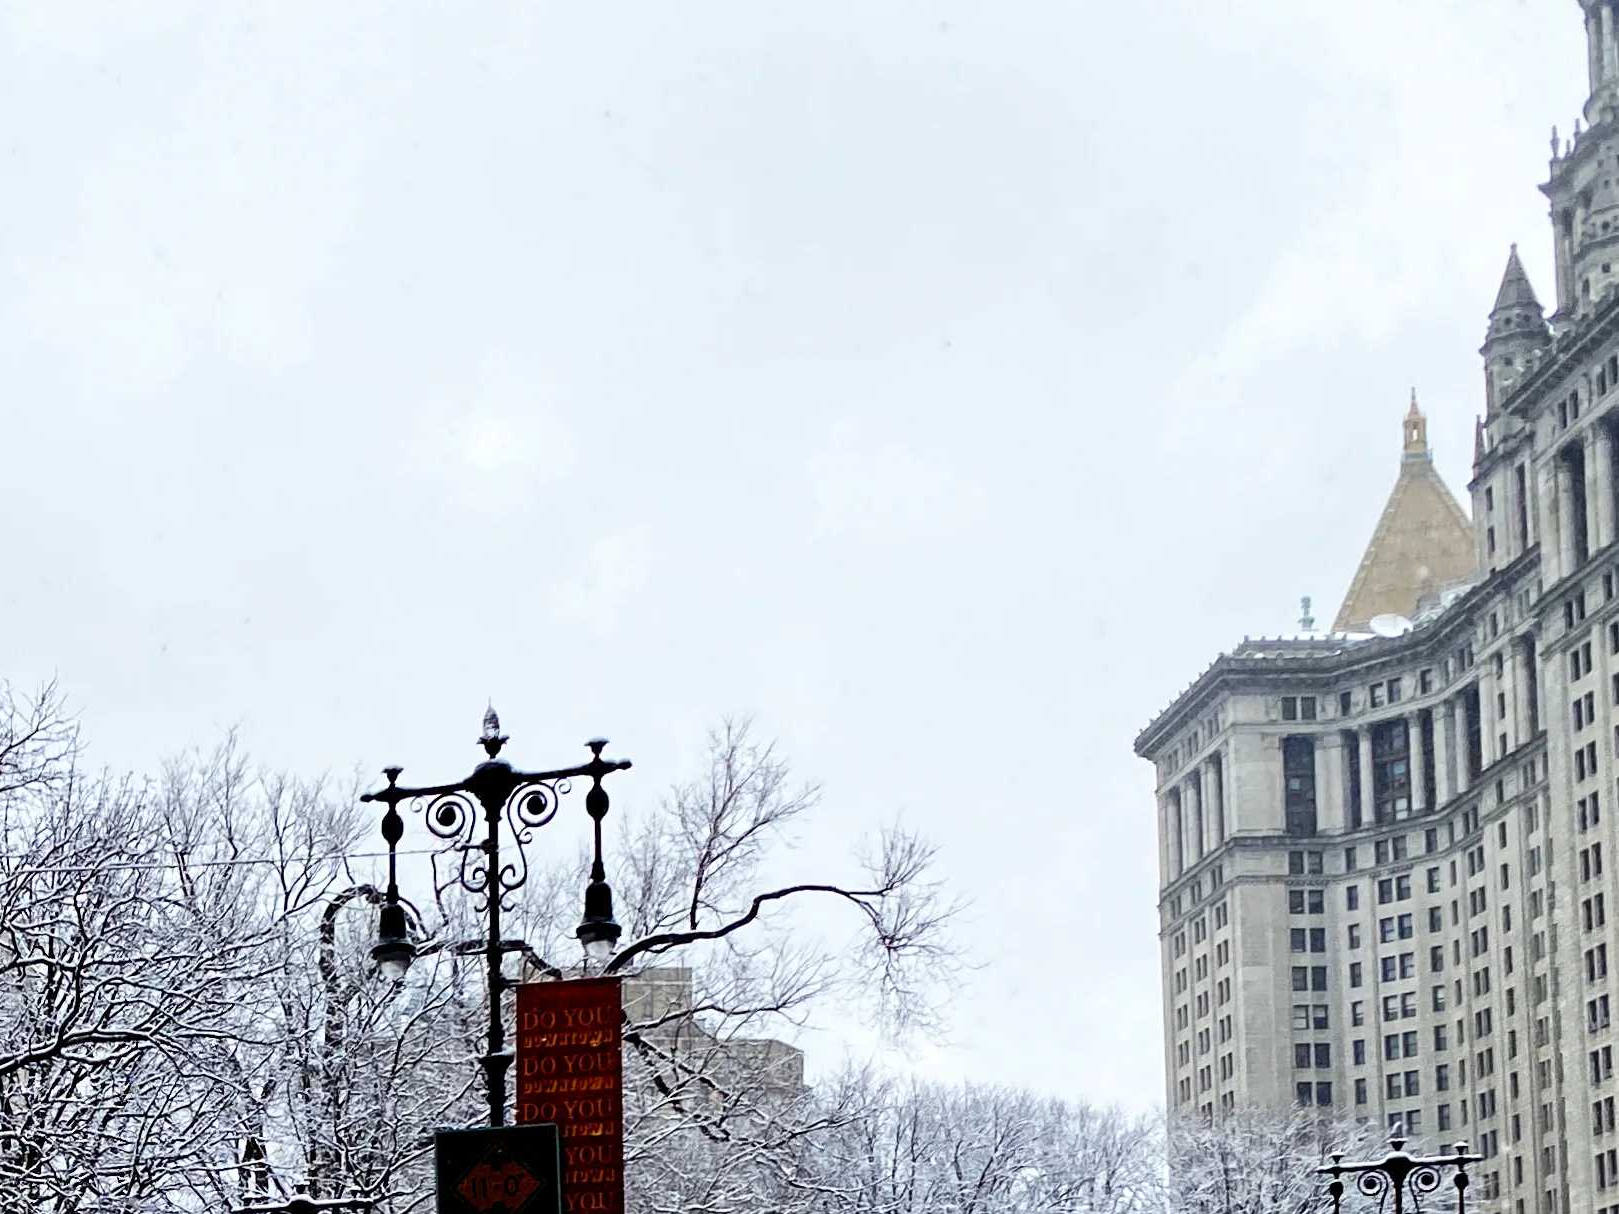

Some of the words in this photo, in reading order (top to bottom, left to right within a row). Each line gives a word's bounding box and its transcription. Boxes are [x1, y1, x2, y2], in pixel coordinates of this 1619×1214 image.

[523, 1010, 556, 1030] DO
[523, 1029, 613, 1048] DOWNTOWN
[523, 1057, 556, 1076] DO
[523, 1076, 614, 1094] DOWNTOWN
[523, 1102, 557, 1121] DO
